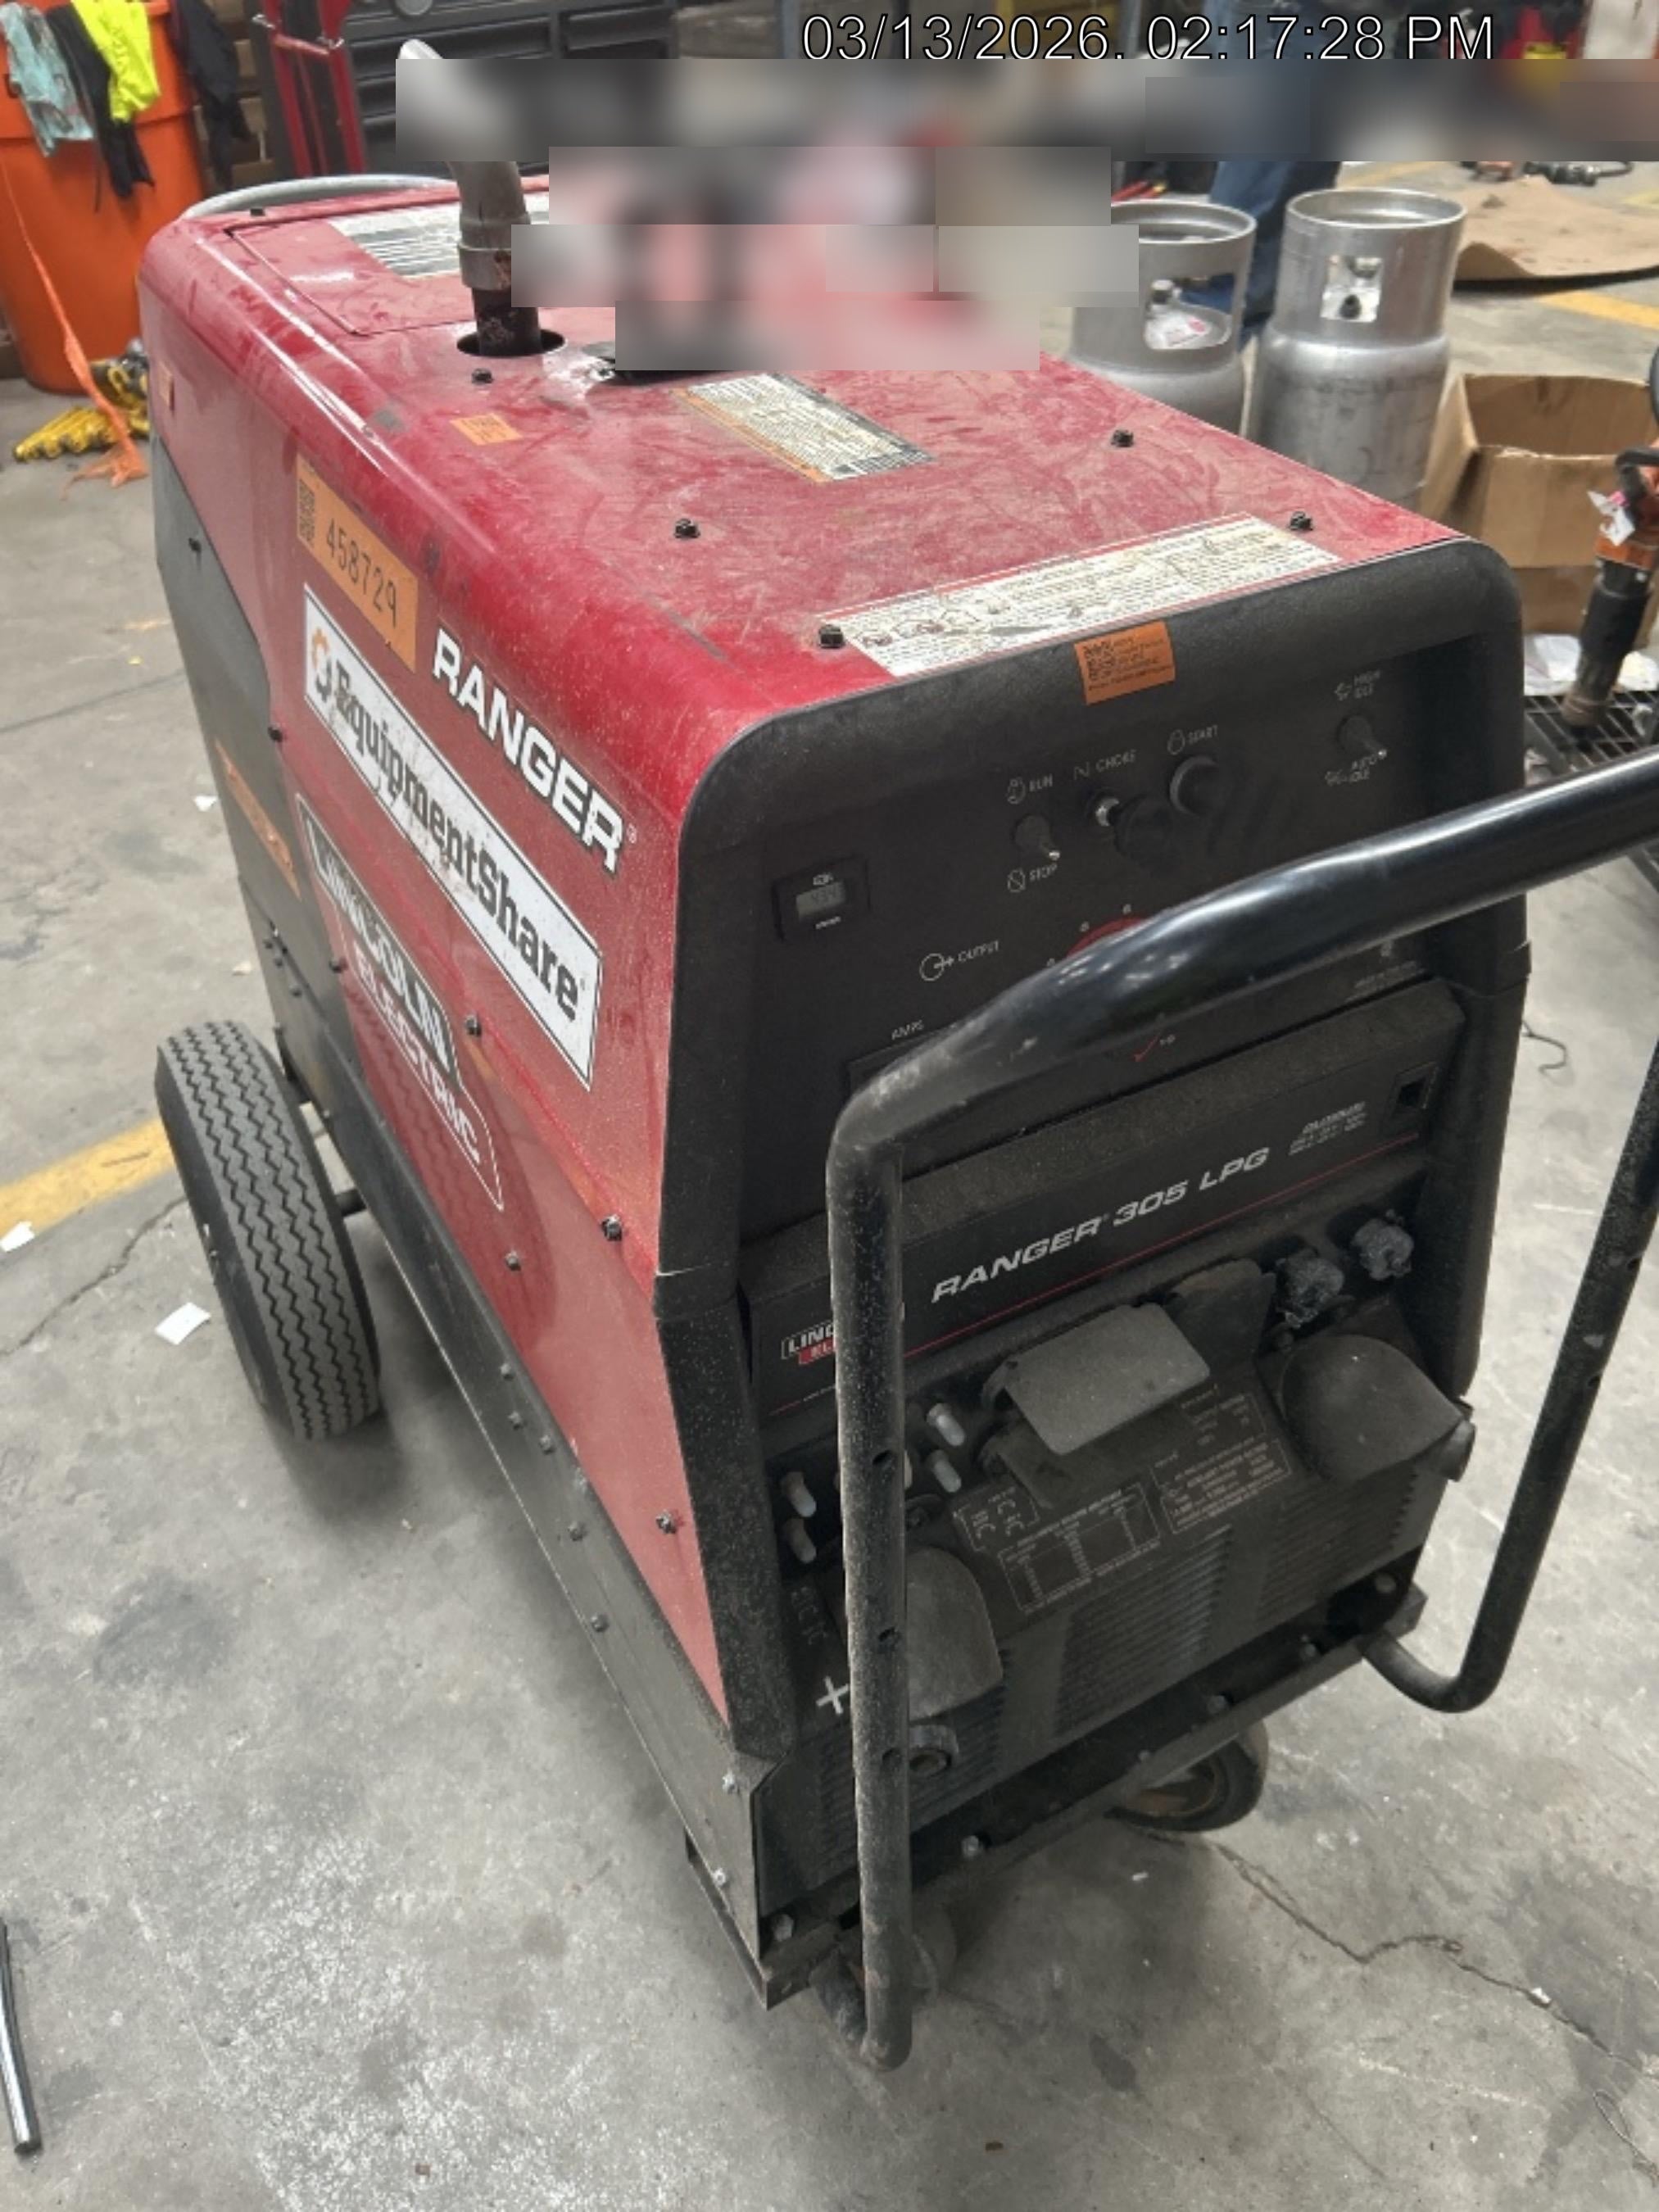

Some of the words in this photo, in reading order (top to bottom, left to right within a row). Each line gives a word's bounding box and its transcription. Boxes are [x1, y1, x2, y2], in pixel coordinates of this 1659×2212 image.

[326, 518, 397, 628] 458729
[433, 628, 623, 873] RANGER
[1188, 725, 1219, 745] START
[1029, 773, 1054, 793] RUN
[333, 659, 579, 1022] EquipmentShare
[1029, 863, 1058, 882] STOP
[305, 814, 451, 1073] LINCOLN
[957, 940, 999, 963] OUTPUT
[352, 939, 481, 1166] ELECTRIC
[891, 1019, 925, 1040] AMPS
[931, 1216, 1102, 1303] RANGER
[1113, 1178, 1190, 1226] 305
[1198, 1146, 1271, 1192] LPG
[788, 1322, 835, 1353] LINC
